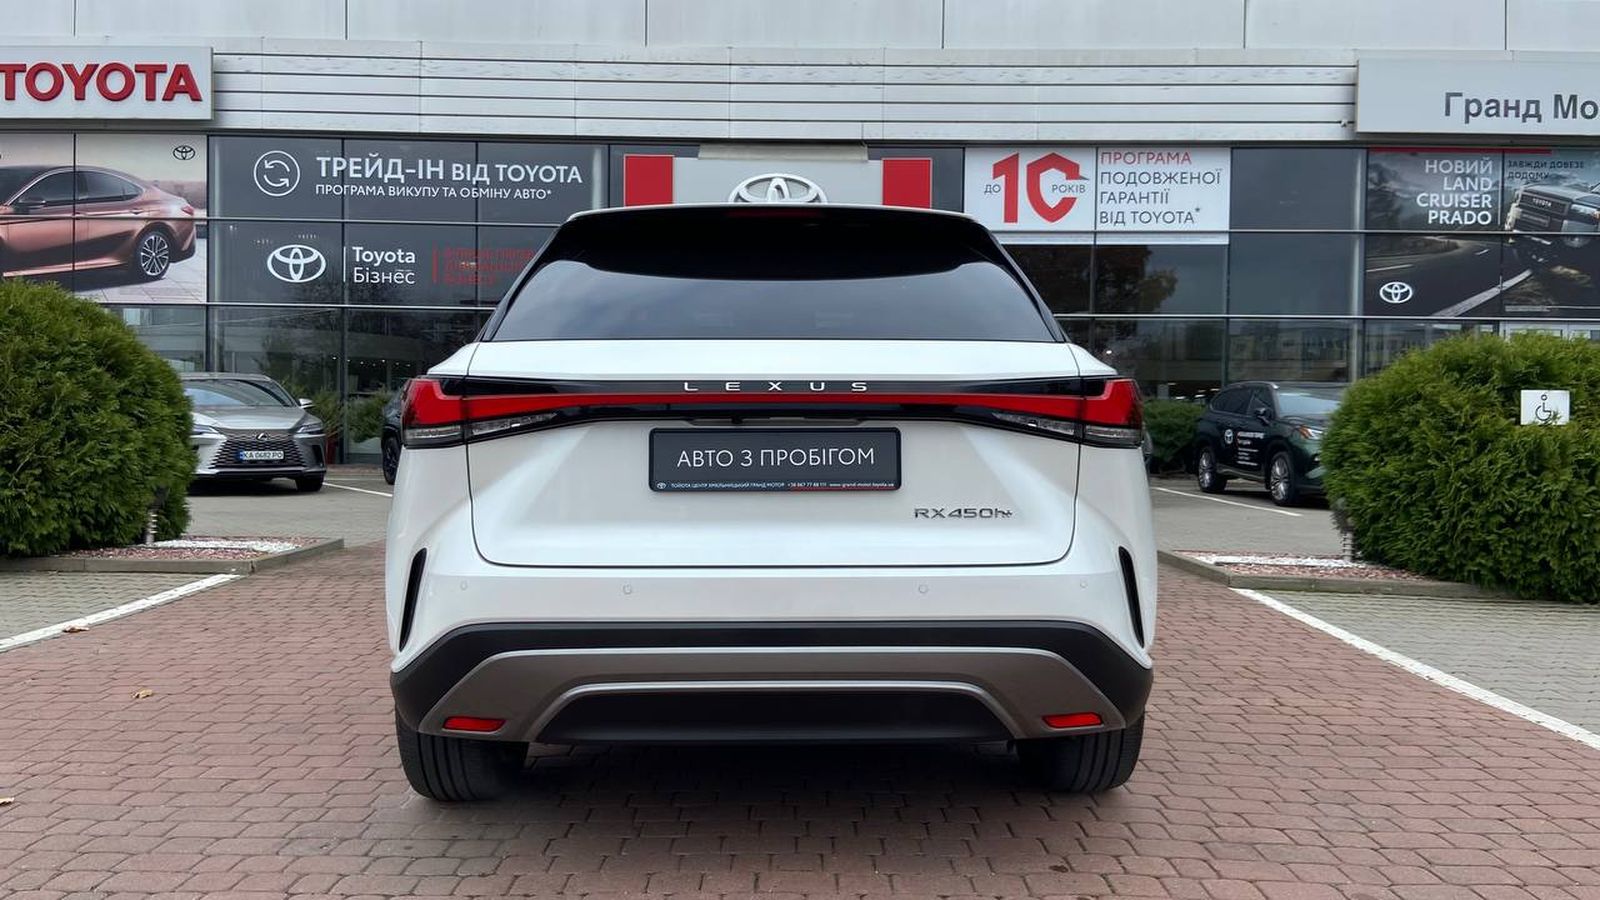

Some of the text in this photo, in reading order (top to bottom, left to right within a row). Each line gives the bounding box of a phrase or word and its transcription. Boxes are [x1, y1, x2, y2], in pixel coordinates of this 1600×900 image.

[0, 62, 202, 102] TOYOTA
[1444, 92, 1600, 123] Гранд Мо
[1100, 151, 1192, 165] ПРОГРАМА
[1425, 157, 1493, 174] НОВИЙ
[316, 152, 584, 185] ТРЕЙД-ІН ВІД TOYOTA
[1507, 171, 1549, 180] ДОДОМУ
[1100, 168, 1222, 187] ПОДОВЖЕНОЇ
[1443, 176, 1493, 191] LAND
[315, 184, 386, 197] ПРОГРАМА
[388, 185, 440, 198] ВИКУПУ
[442, 186, 457, 198] ТА
[460, 187, 511, 199] ОБМІНУ
[984, 184, 1001, 195] ДО
[1051, 183, 1087, 194] РОКІВ
[1100, 188, 1169, 205] ГАРАНТІЇ
[1416, 192, 1493, 208] CRUISER
[1099, 211, 1126, 226] ВІД
[1428, 210, 1493, 226] PRADO
[352, 246, 416, 267] Toyota
[352, 267, 415, 285] Бізнес
[683, 381, 868, 392] LEXUS
[676, 448, 734, 469] АВТО
[760, 446, 876, 468] ПРОБІГОМ
